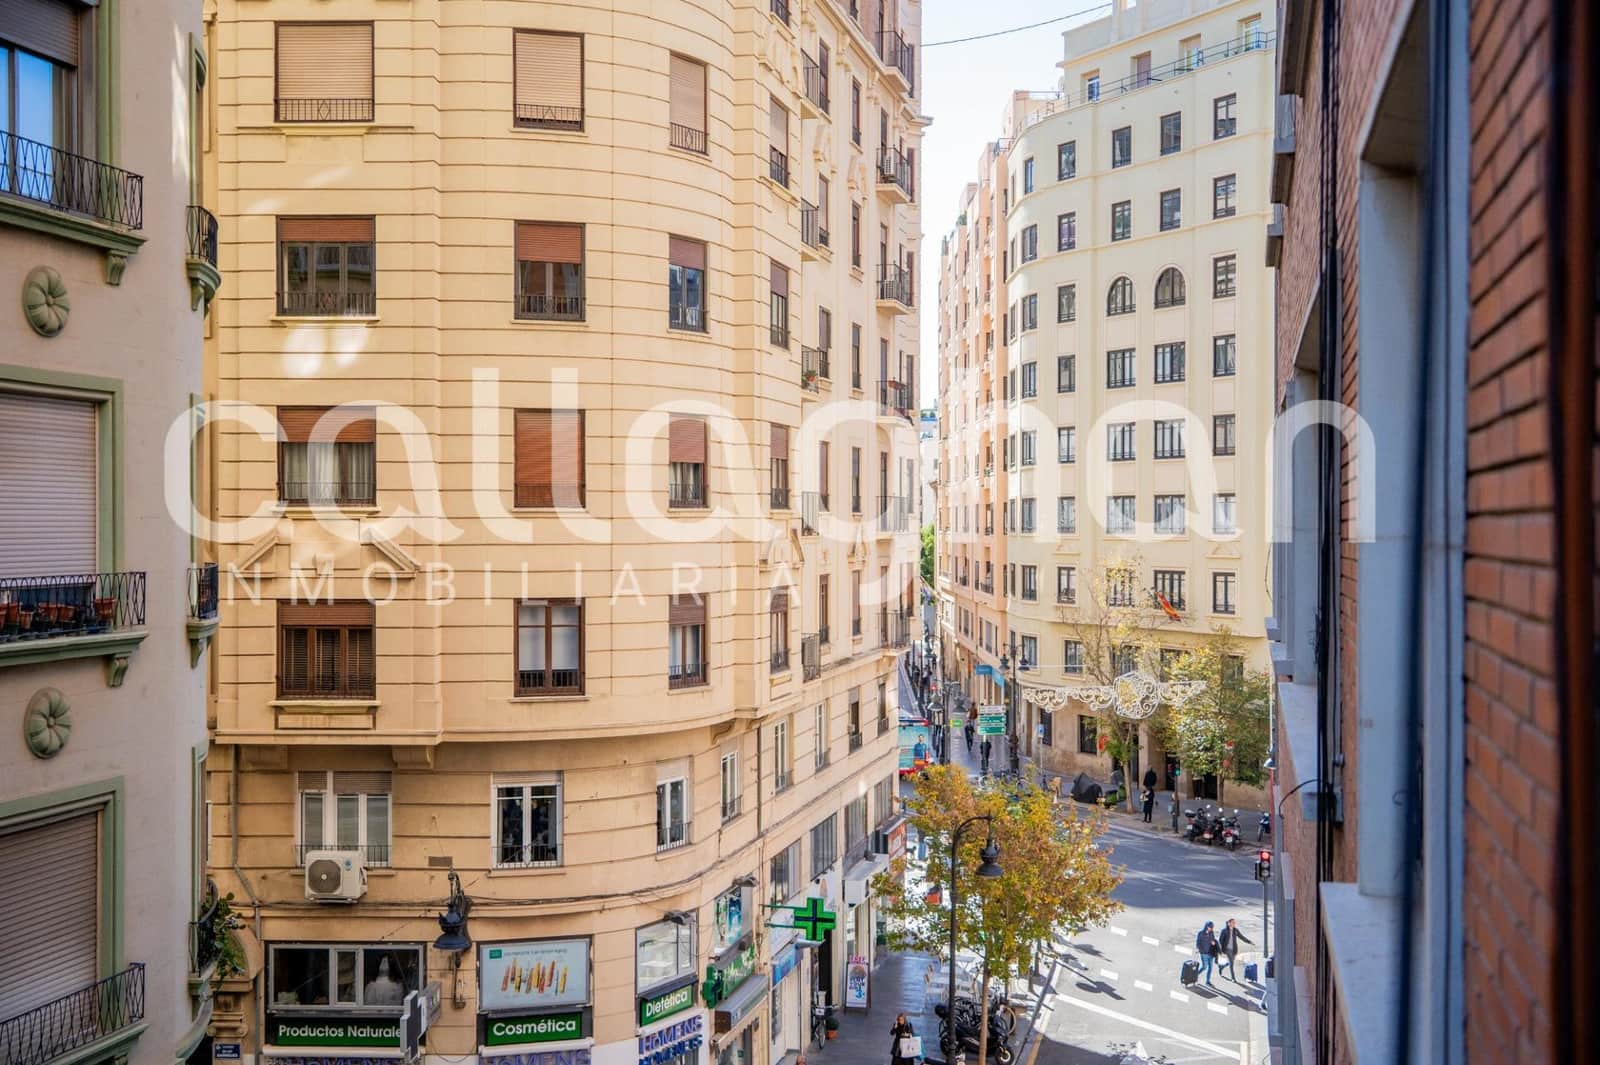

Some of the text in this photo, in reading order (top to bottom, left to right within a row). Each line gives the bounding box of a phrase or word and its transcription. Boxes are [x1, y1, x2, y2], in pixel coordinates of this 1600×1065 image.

[645, 989, 688, 1017] Dietética
[278, 1024, 401, 1038] Productos Naturale
[492, 1018, 577, 1037] Cosmética
